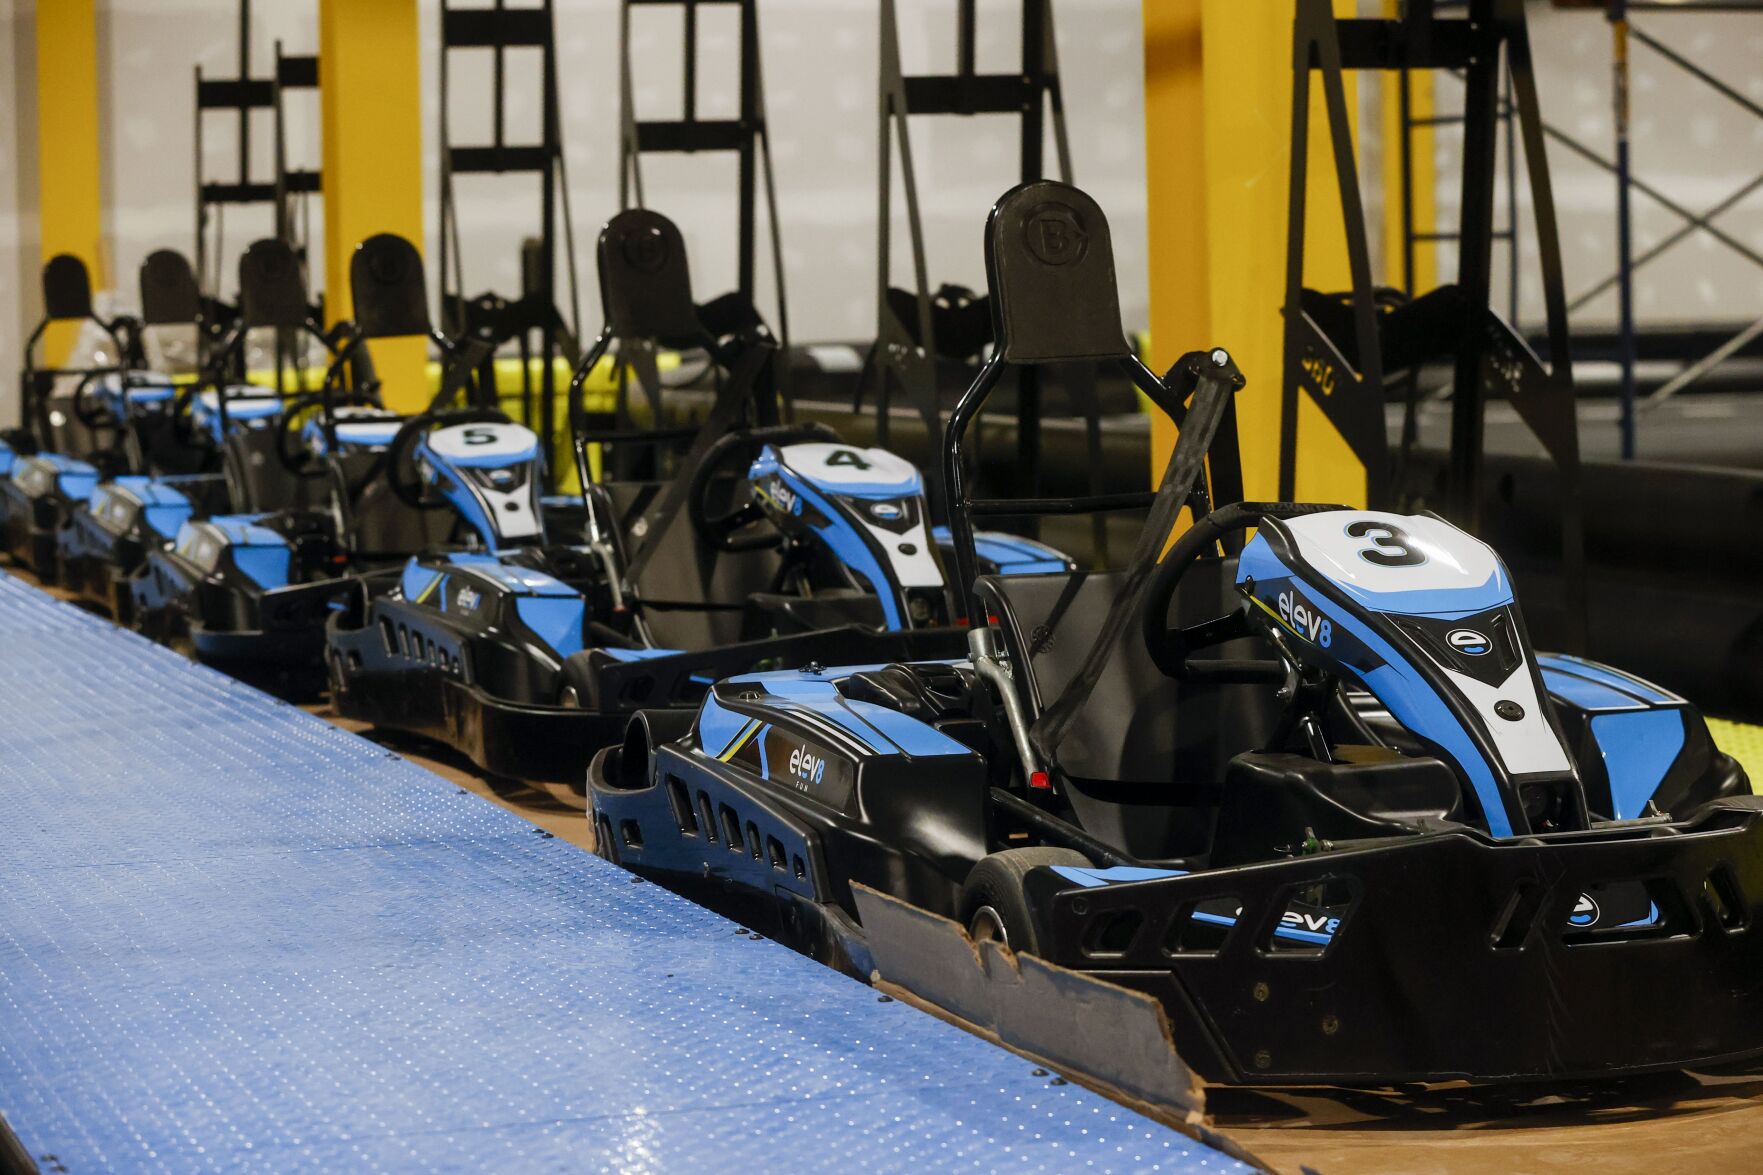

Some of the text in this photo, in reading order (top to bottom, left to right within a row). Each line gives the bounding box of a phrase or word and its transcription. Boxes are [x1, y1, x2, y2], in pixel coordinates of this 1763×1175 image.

[463, 428, 498, 446] 5
[825, 450, 872, 470] 4
[1345, 521, 1429, 568] 3
[1278, 590, 1332, 648] elev8
[789, 744, 825, 785] elev8
[795, 781, 809, 792] FUN
